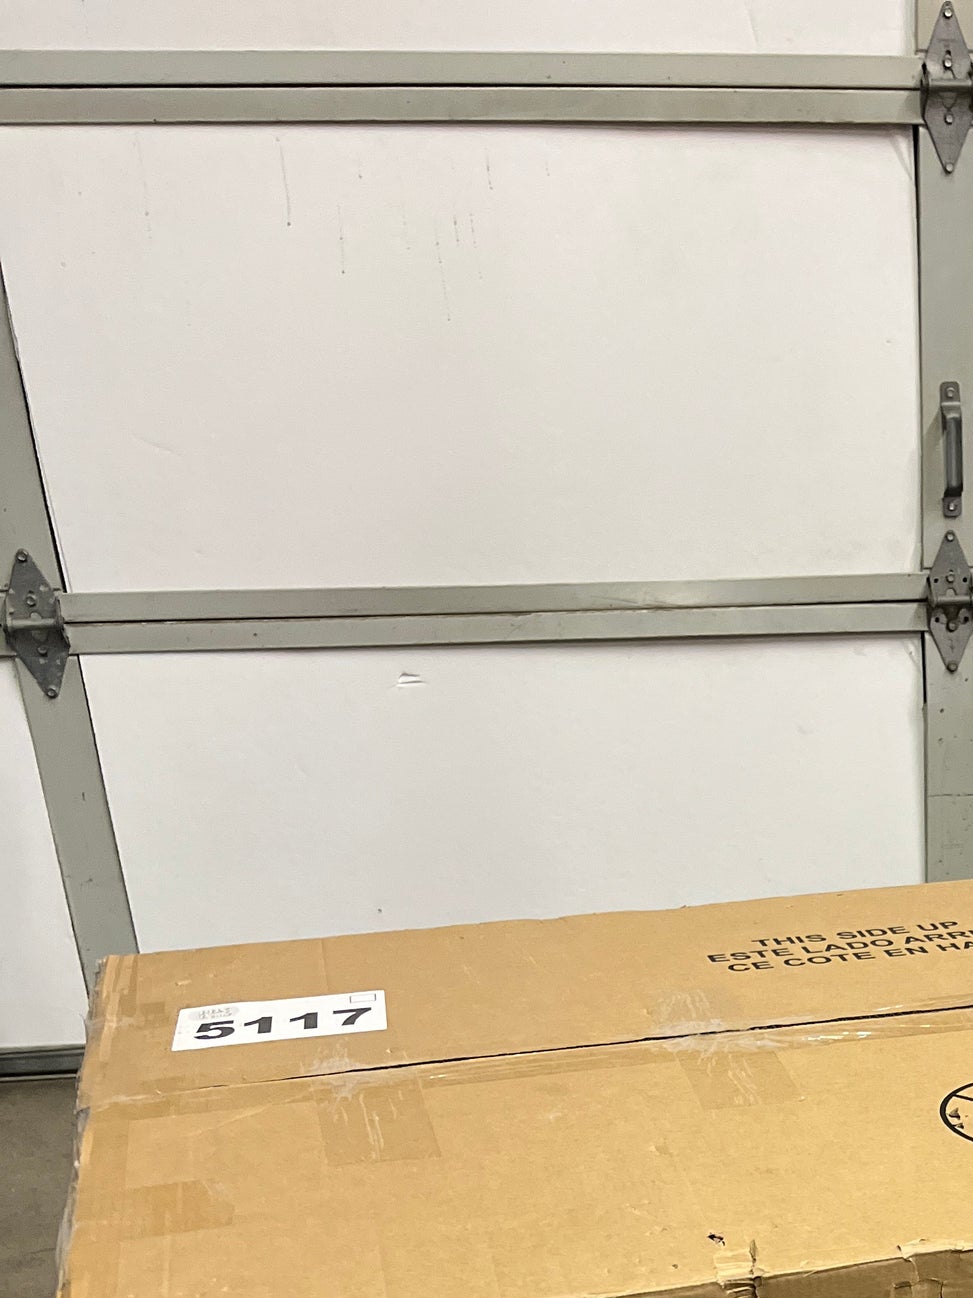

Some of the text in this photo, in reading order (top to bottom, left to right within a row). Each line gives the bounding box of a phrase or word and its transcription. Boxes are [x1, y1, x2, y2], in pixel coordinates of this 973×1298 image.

[751, 921, 959, 947] THIS SIDE UP
[707, 947, 794, 964] ESTE
[801, 938, 894, 954] LADO
[727, 961, 774, 973] CE
[783, 951, 876, 968] COTE
[883, 946, 929, 958] EN
[193, 1007, 372, 1040] 5117
